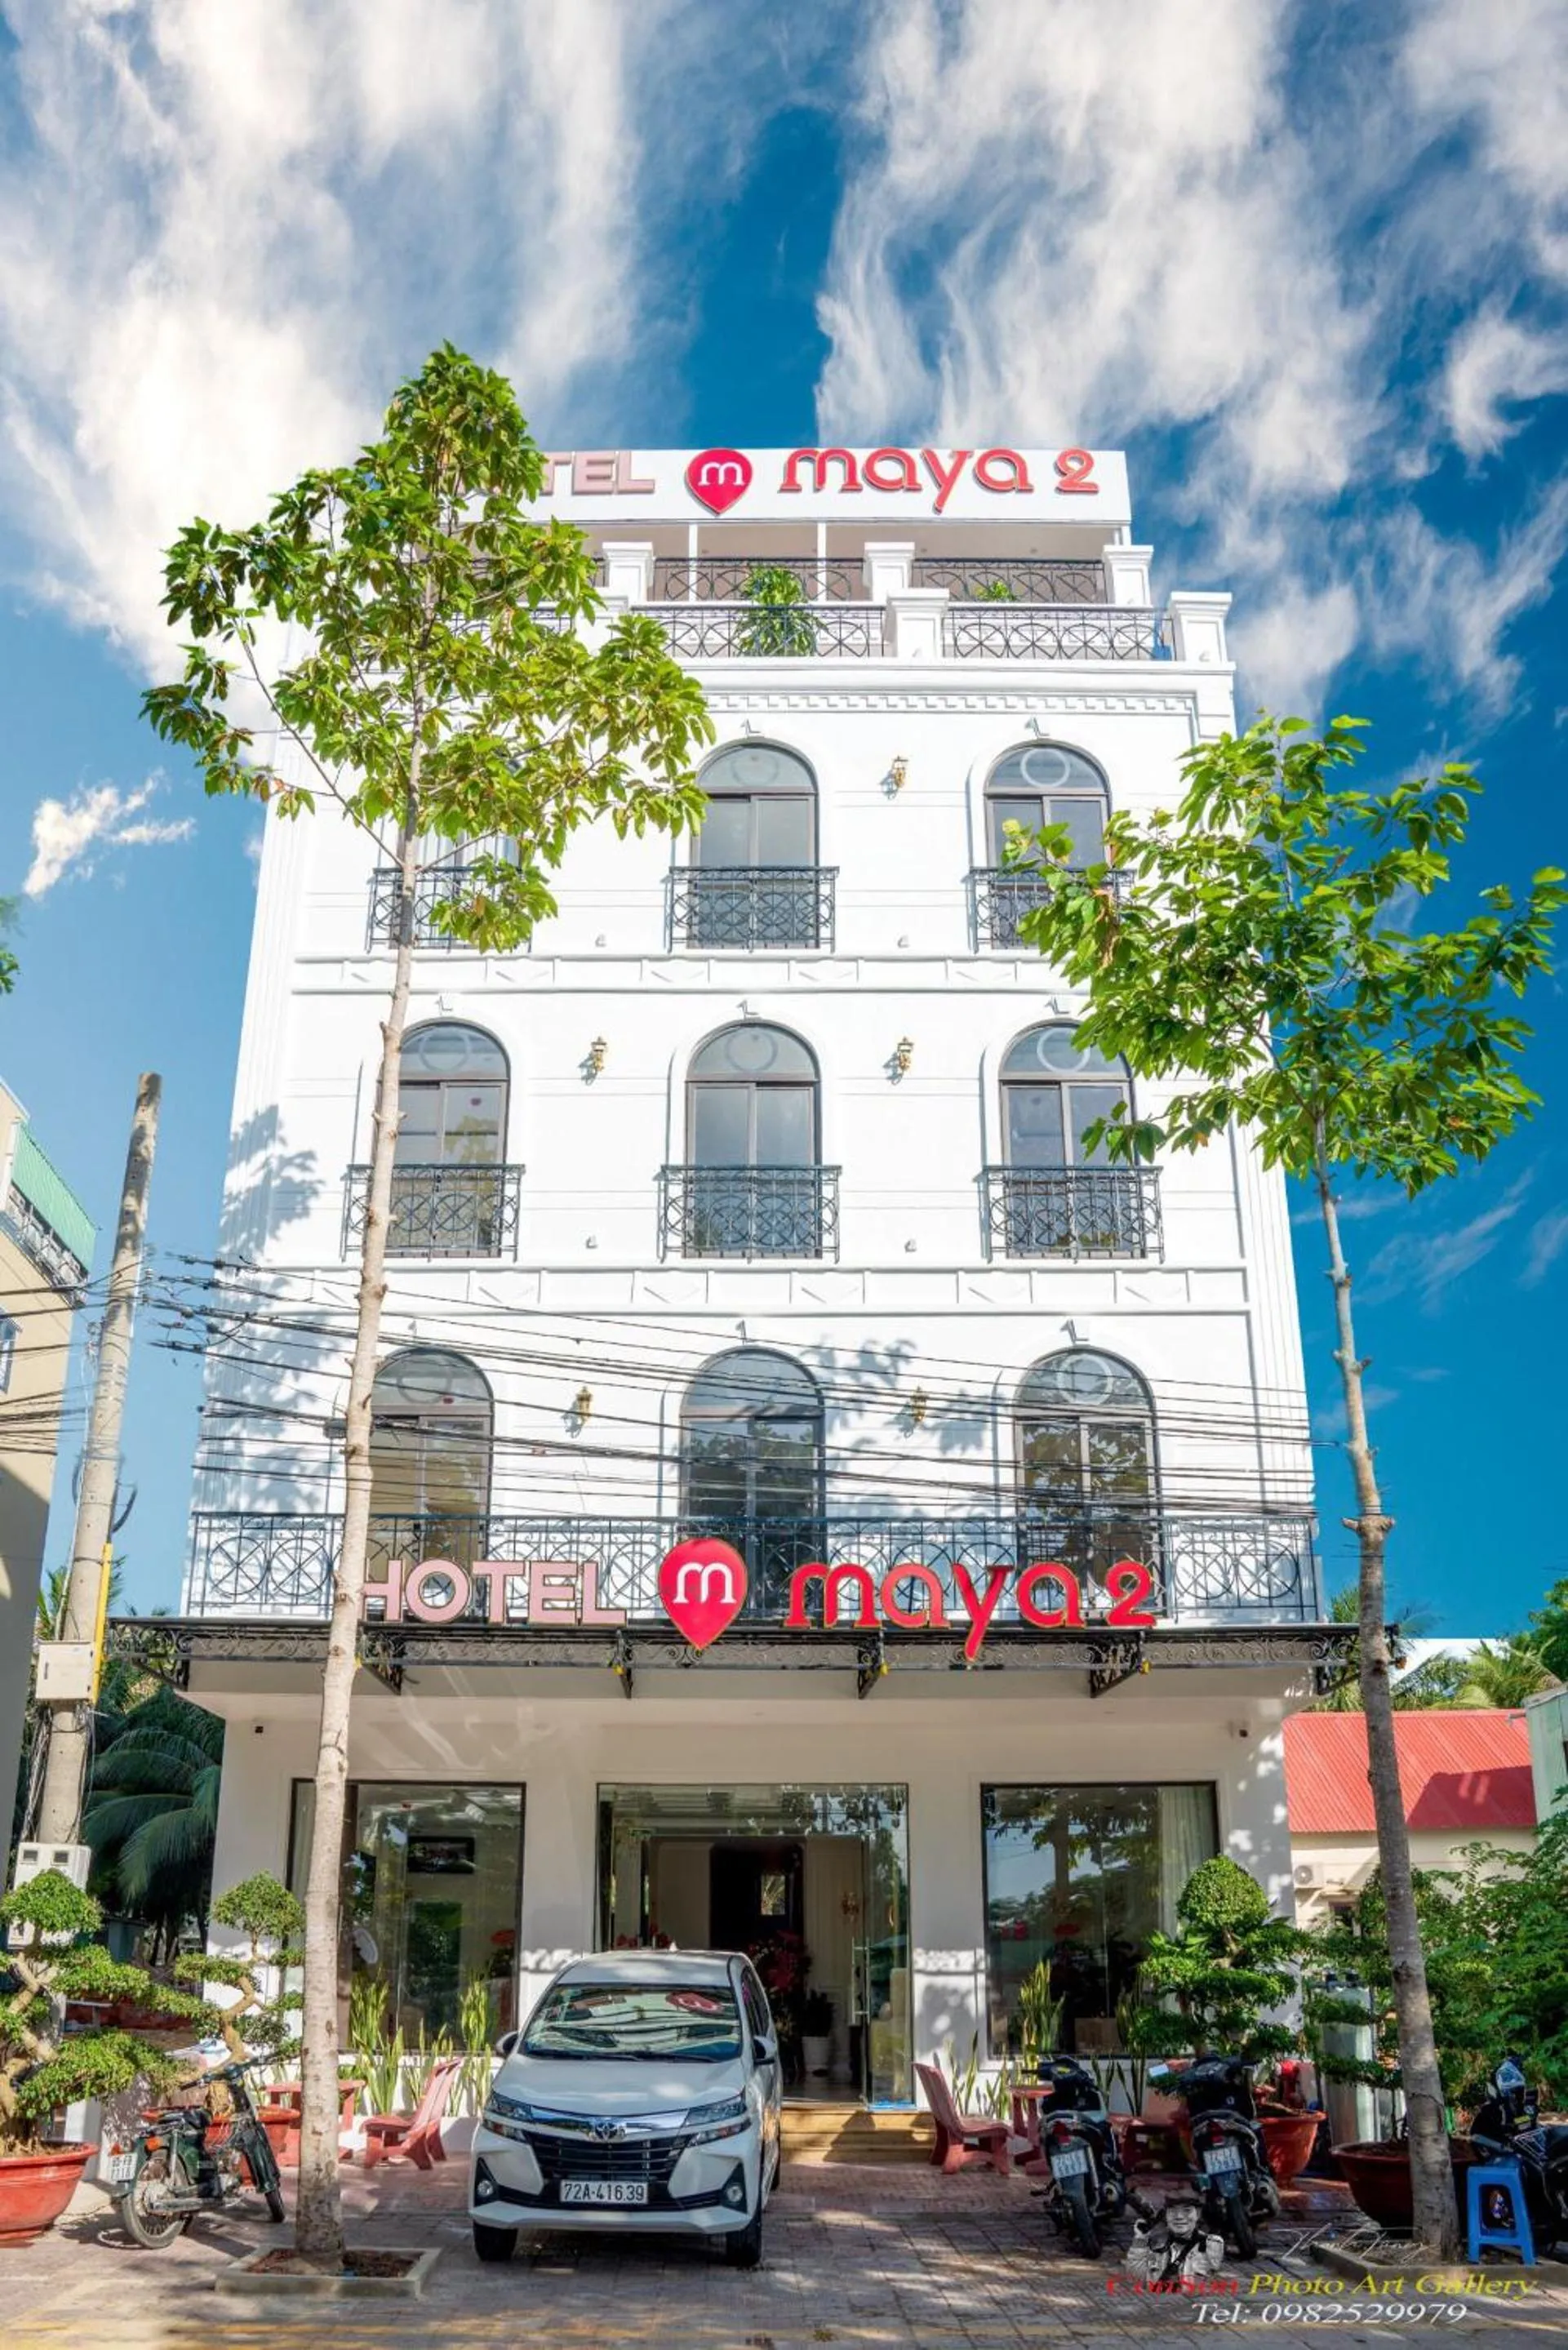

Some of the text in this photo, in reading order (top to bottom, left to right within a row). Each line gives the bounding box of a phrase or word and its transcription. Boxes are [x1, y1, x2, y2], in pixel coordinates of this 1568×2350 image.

[492, 451, 655, 495] TEL
[778, 447, 1034, 514] maya
[1054, 447, 1099, 495] 2
[362, 1558, 627, 1628] HOTEL
[783, 1561, 1086, 1663] maya
[1104, 1560, 1157, 1628] 2
